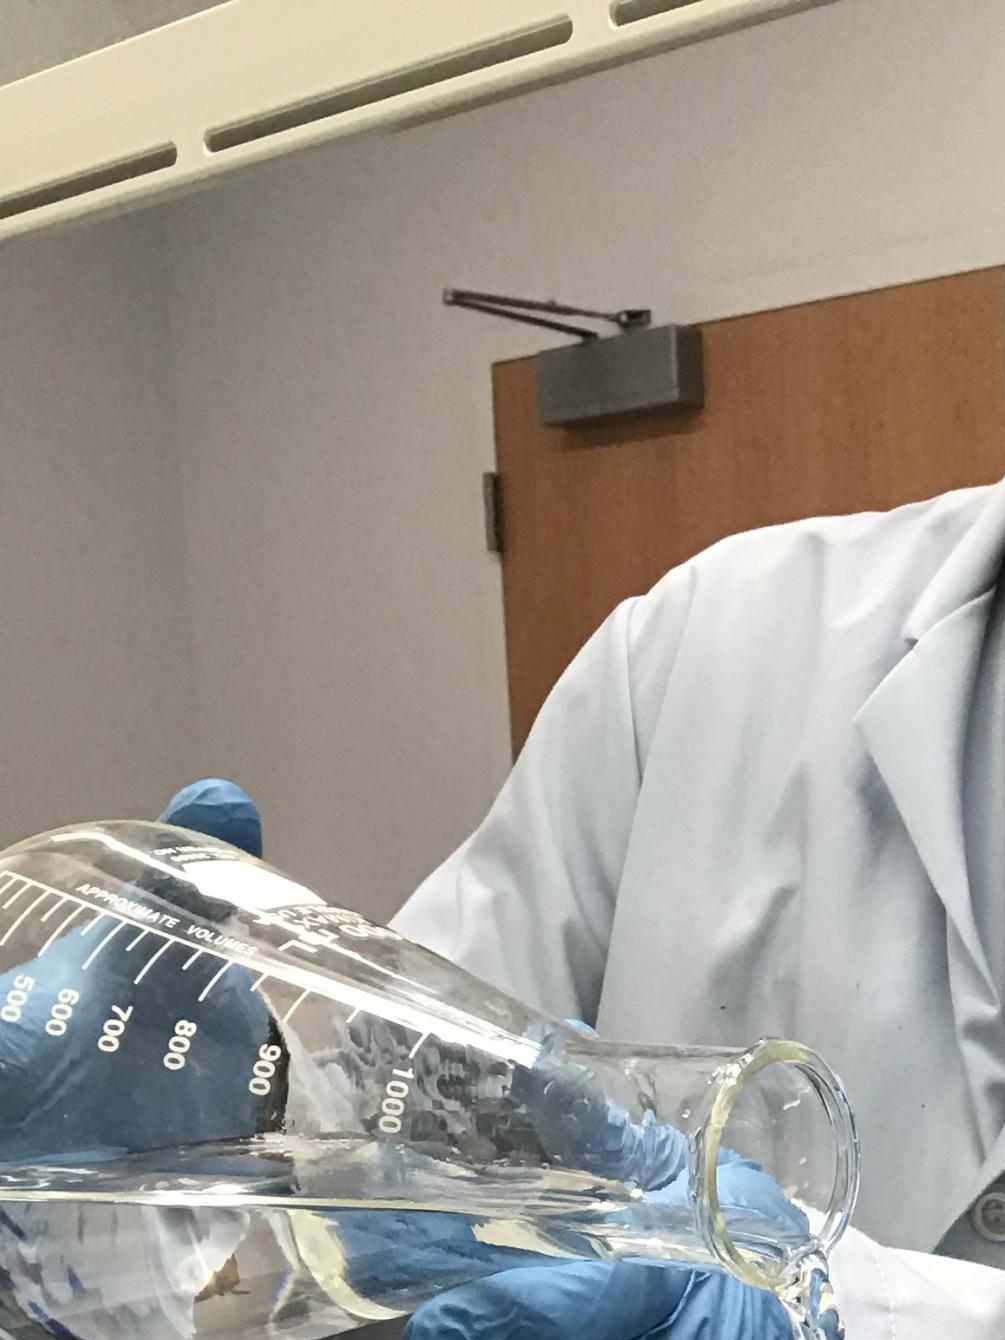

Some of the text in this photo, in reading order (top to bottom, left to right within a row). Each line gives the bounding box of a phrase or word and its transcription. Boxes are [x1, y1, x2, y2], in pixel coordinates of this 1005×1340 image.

[75, 884, 258, 956] APPROXIMATE VOLUMES
[0, 974, 36, 1022] 500
[45, 988, 79, 1036] 600
[97, 1005, 133, 1053] 700
[163, 1019, 197, 1070] 800
[248, 1043, 282, 1096] 900
[378, 1066, 415, 1134] 1000
